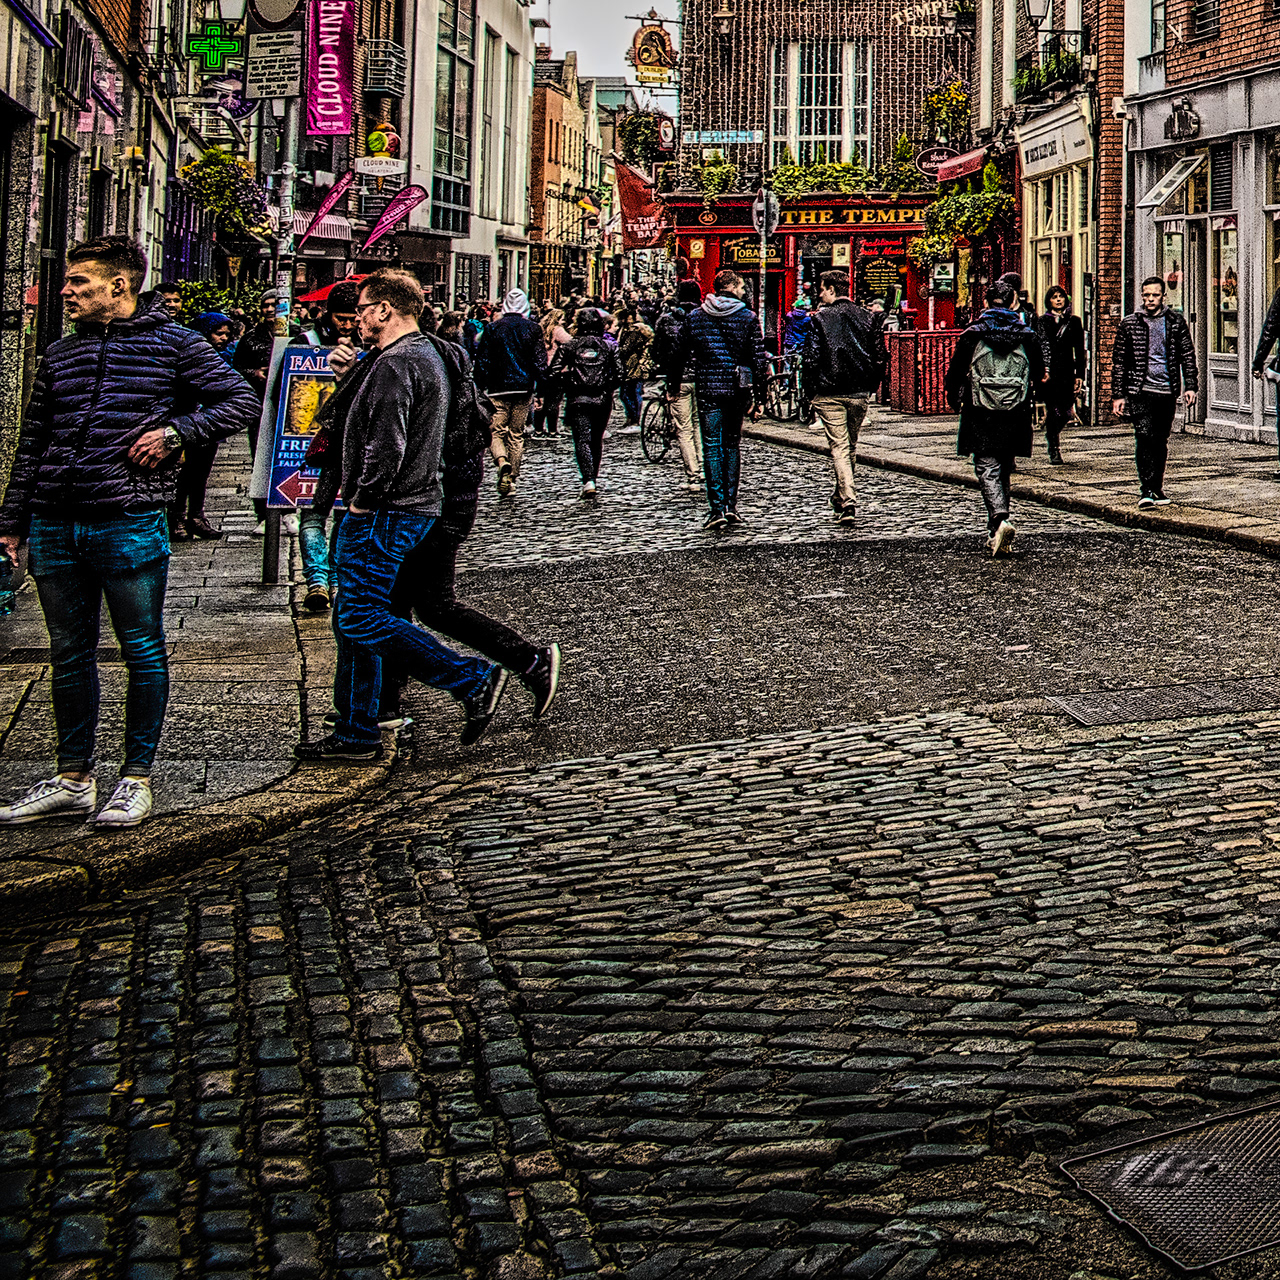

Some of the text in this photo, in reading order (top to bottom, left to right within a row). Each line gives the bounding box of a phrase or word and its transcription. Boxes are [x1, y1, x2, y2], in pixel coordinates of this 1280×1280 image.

[319, 1, 346, 46] NINE
[317, 53, 343, 115] CLOUD
[781, 210, 833, 224] THE
[626, 221, 667, 231] TEMPLE
[638, 230, 659, 238] BAR
